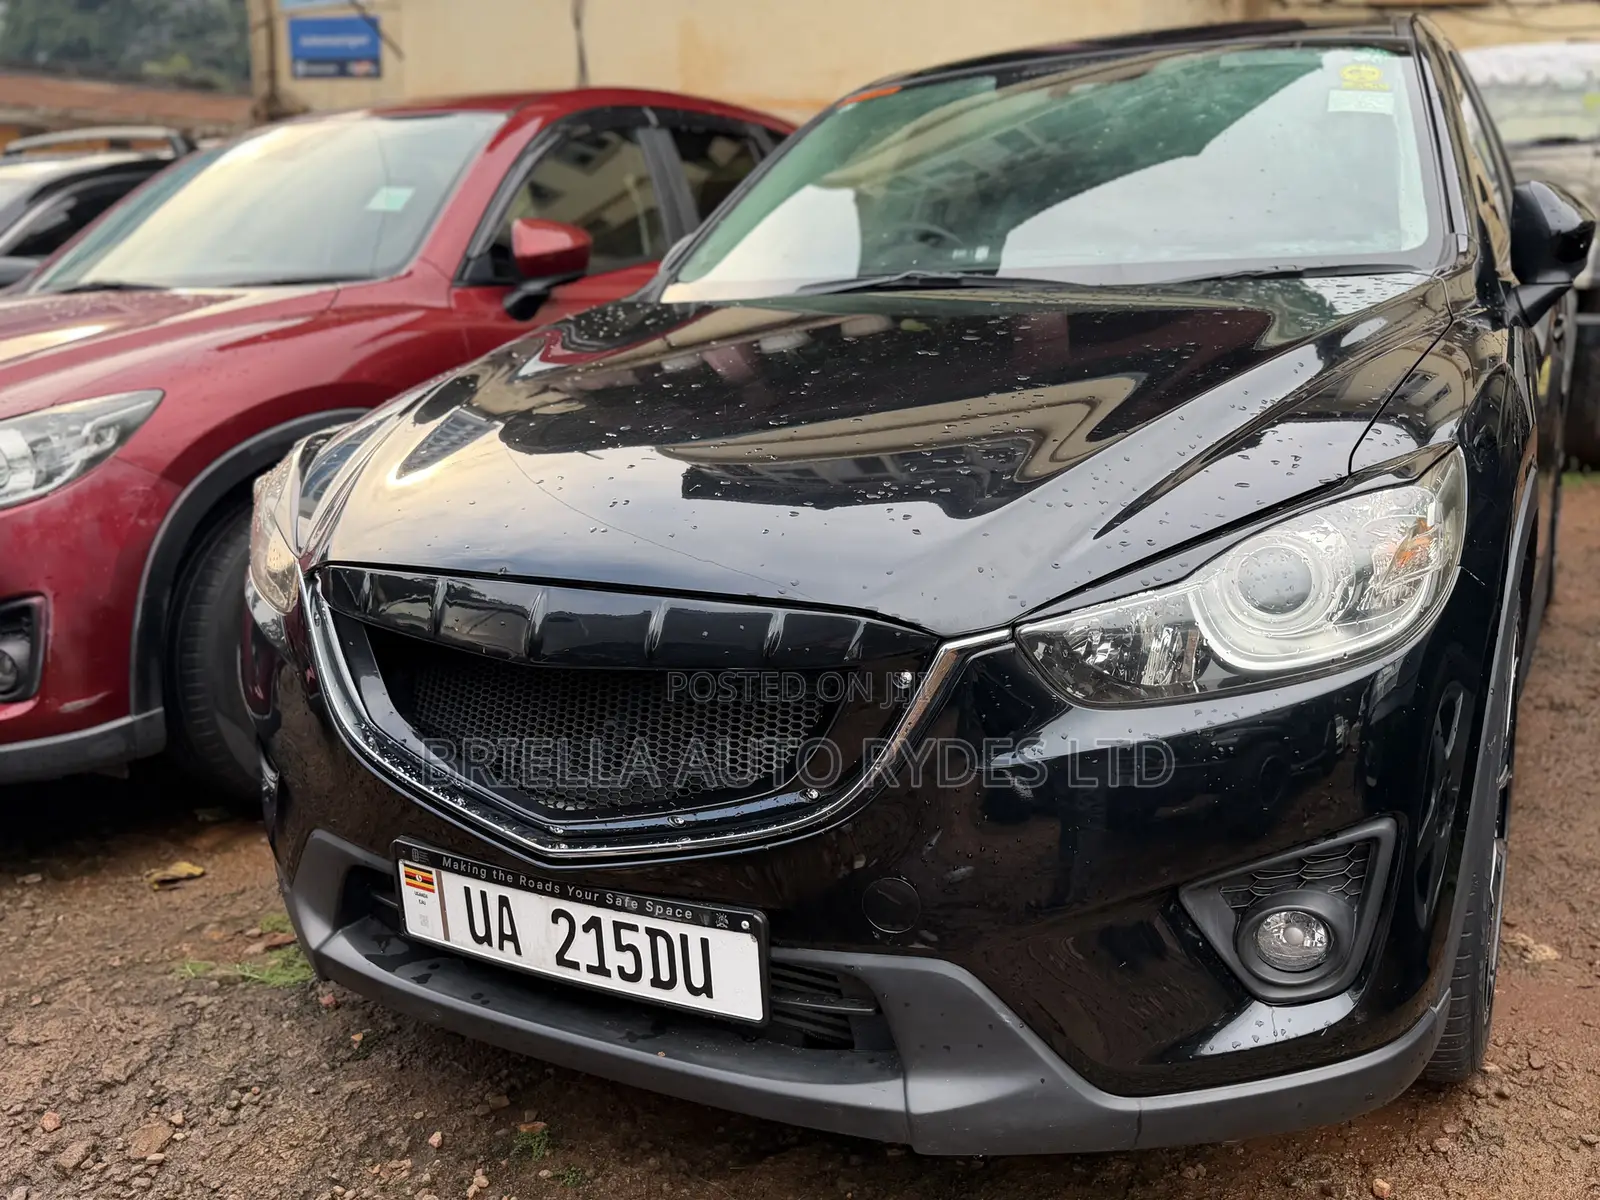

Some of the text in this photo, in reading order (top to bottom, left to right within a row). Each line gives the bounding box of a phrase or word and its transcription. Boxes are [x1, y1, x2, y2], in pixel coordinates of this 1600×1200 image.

[442, 856, 487, 878] Making
[493, 870, 513, 883] the
[519, 874, 560, 893] Roads
[567, 885, 600, 902] Your
[605, 892, 638, 910] Safe
[645, 900, 693, 919] Space
[463, 885, 714, 1000] UA 215DU
